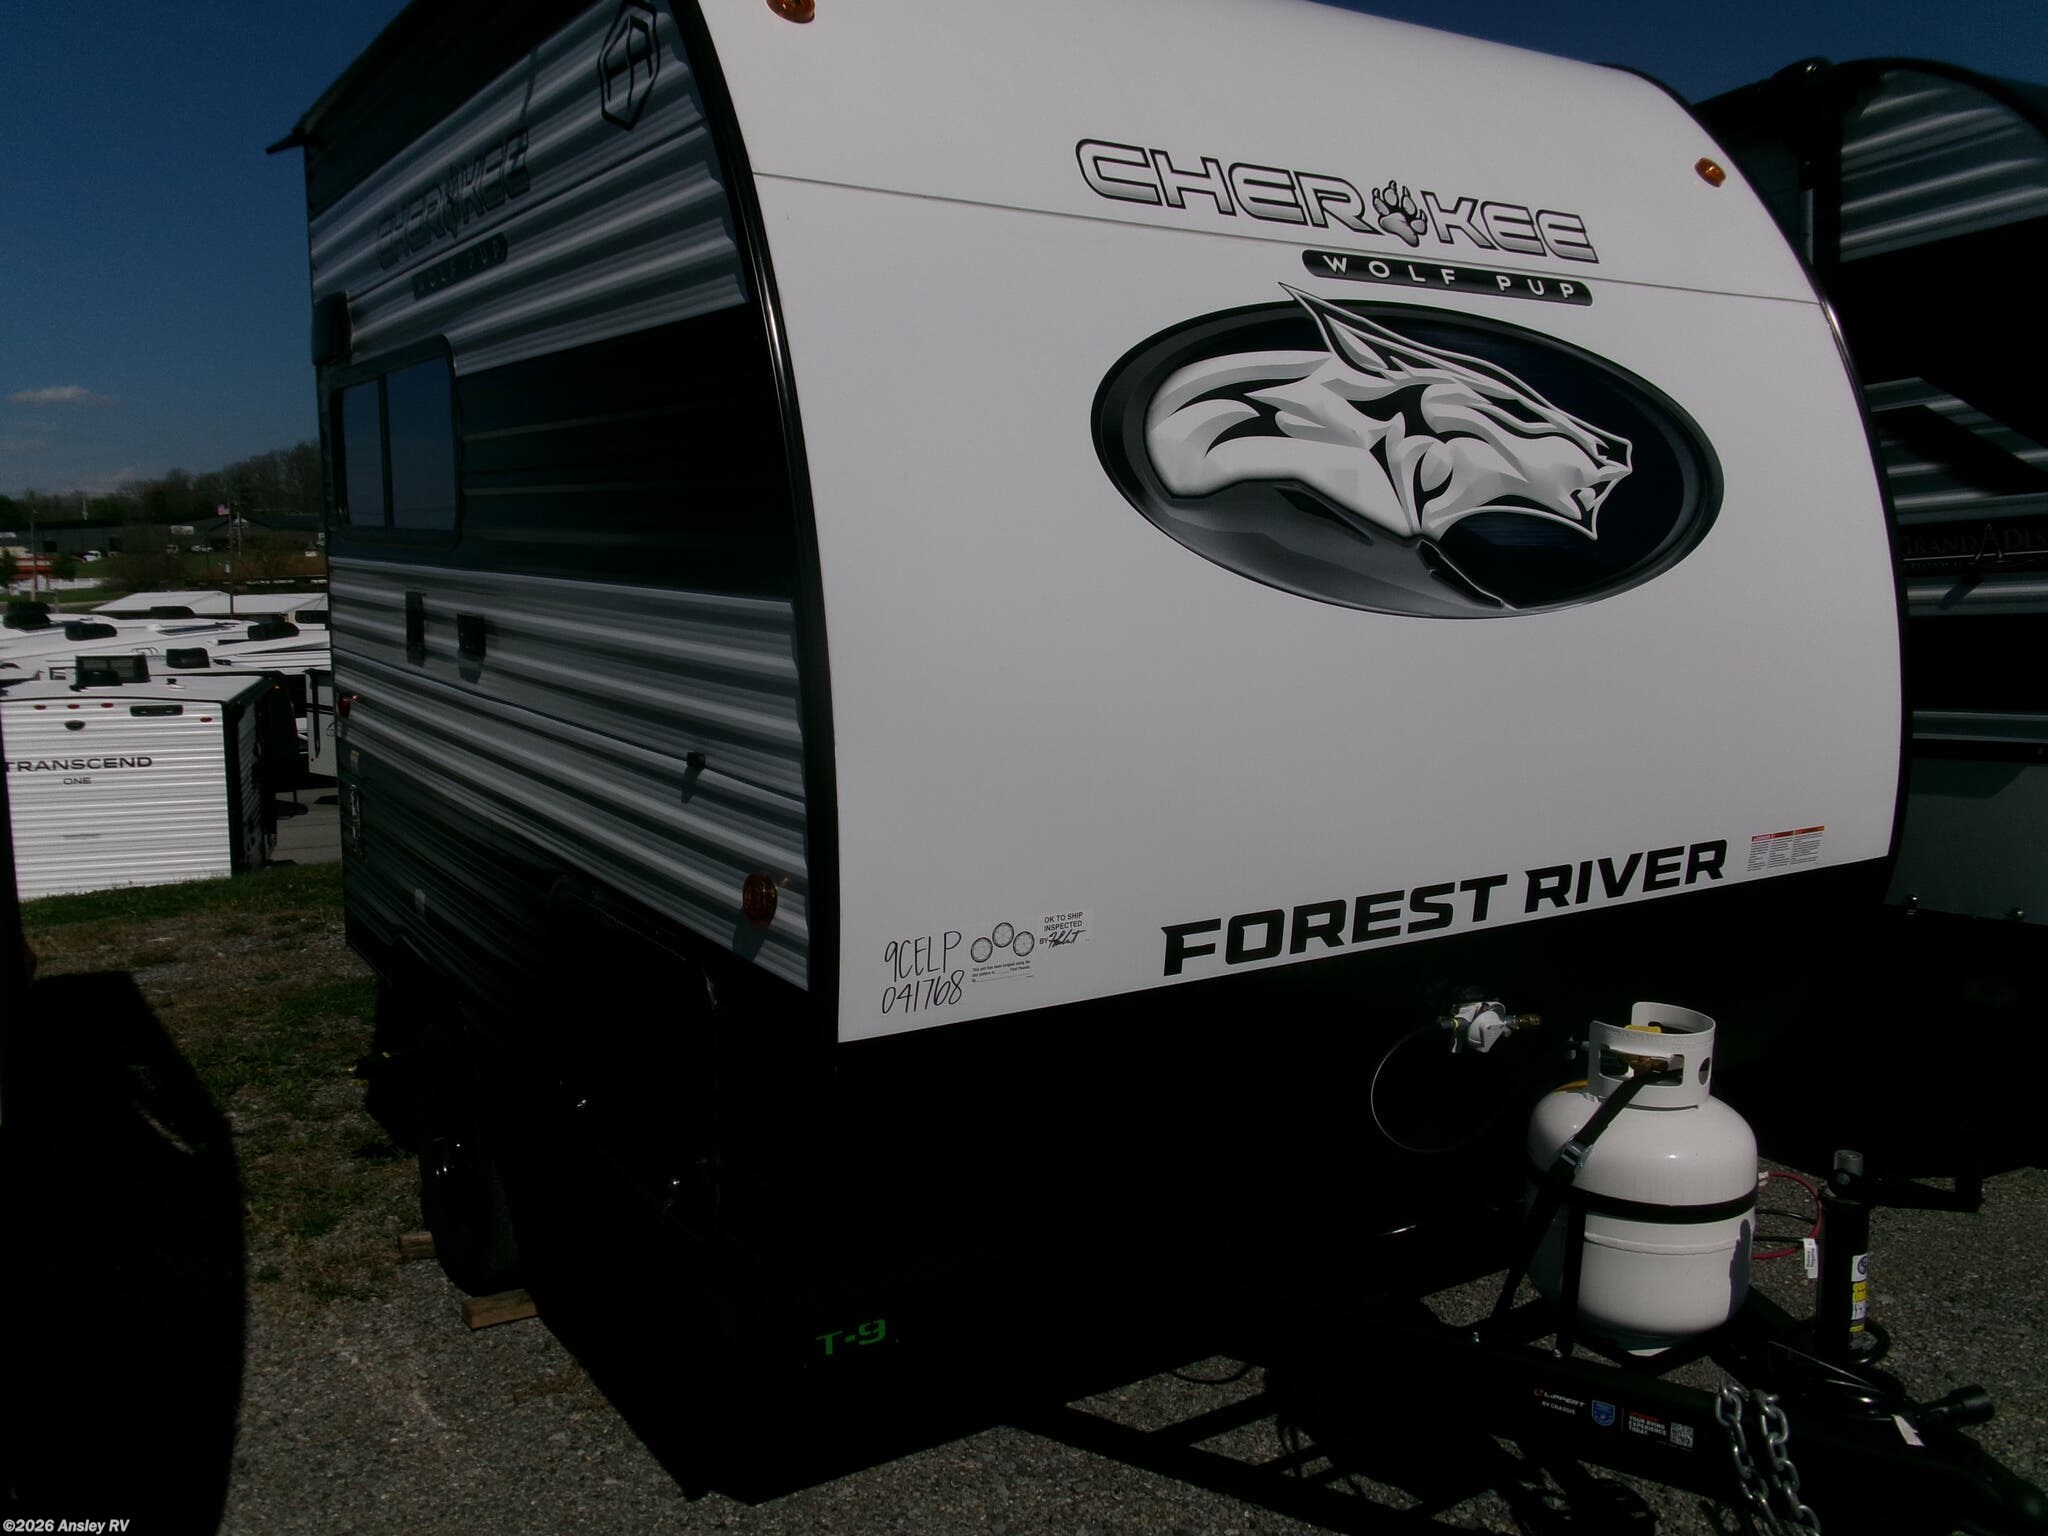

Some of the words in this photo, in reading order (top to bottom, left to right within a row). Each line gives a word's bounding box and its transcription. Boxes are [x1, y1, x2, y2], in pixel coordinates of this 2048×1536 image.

[1321, 254, 1457, 288] WOLF
[1495, 274, 1577, 300] PUP
[63, 777, 92, 785] ONE
[1044, 915, 1055, 924] OK
[1056, 914, 1066, 922] TO
[1067, 911, 1084, 921] SHIP
[1044, 920, 1083, 932] INSPECTED
[1160, 873, 1508, 977] FOREST
[1524, 839, 1728, 914] RIVER
[882, 969, 965, 1014] 041768
[816, 1318, 887, 1356] T-9
